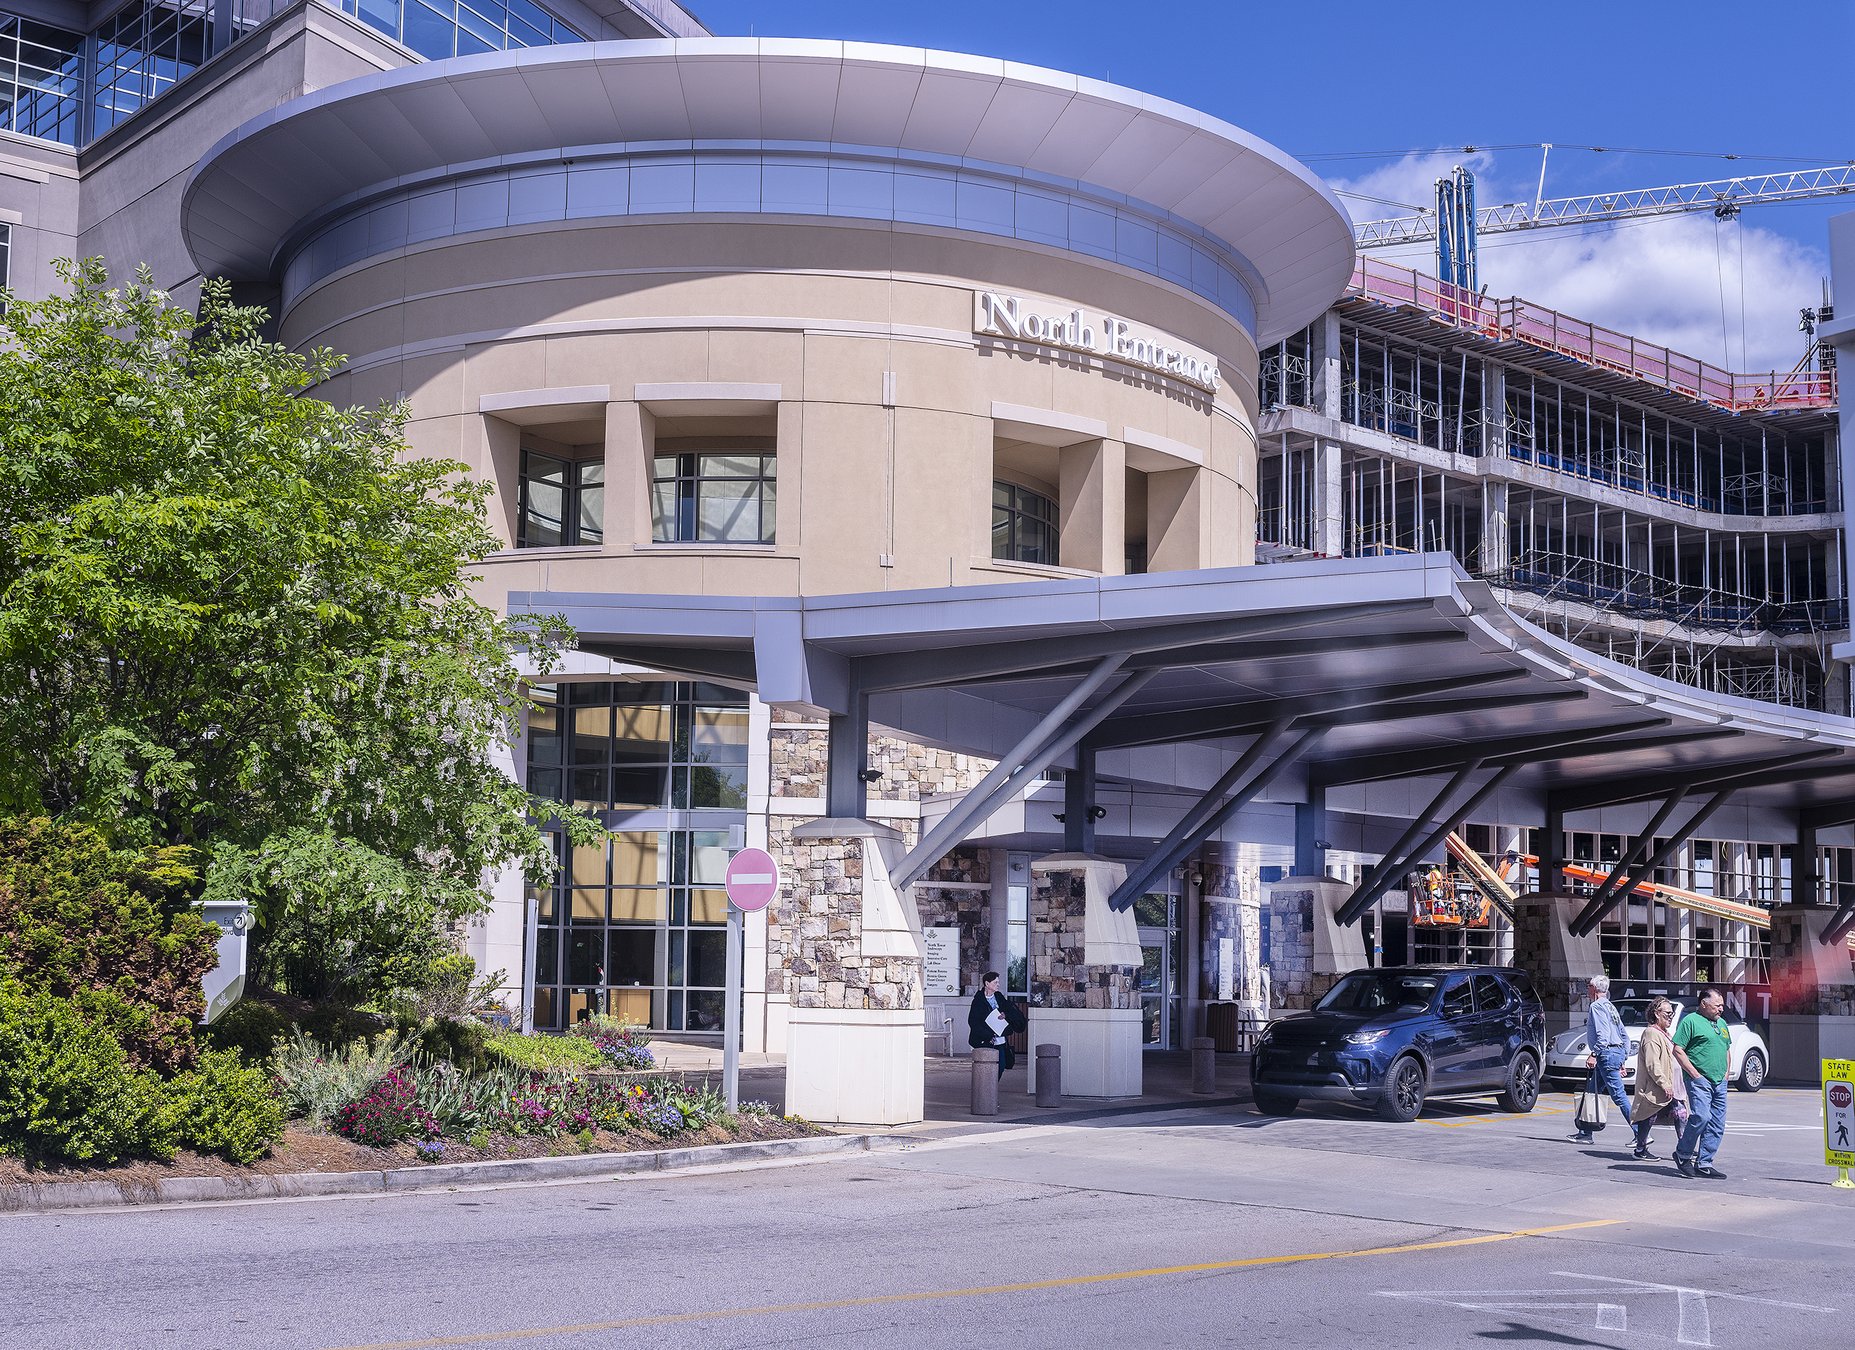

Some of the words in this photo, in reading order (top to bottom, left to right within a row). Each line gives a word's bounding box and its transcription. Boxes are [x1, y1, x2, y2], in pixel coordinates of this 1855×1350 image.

[981, 290, 1096, 351] North
[1103, 316, 1222, 390] Entrance
[1827, 1062, 1851, 1071] STATE
[1831, 1071, 1848, 1079] LAW
[1830, 1091, 1851, 1102] STOP
[1835, 1111, 1847, 1119] FOR
[1828, 1158, 1855, 1167] CROSSWAL
